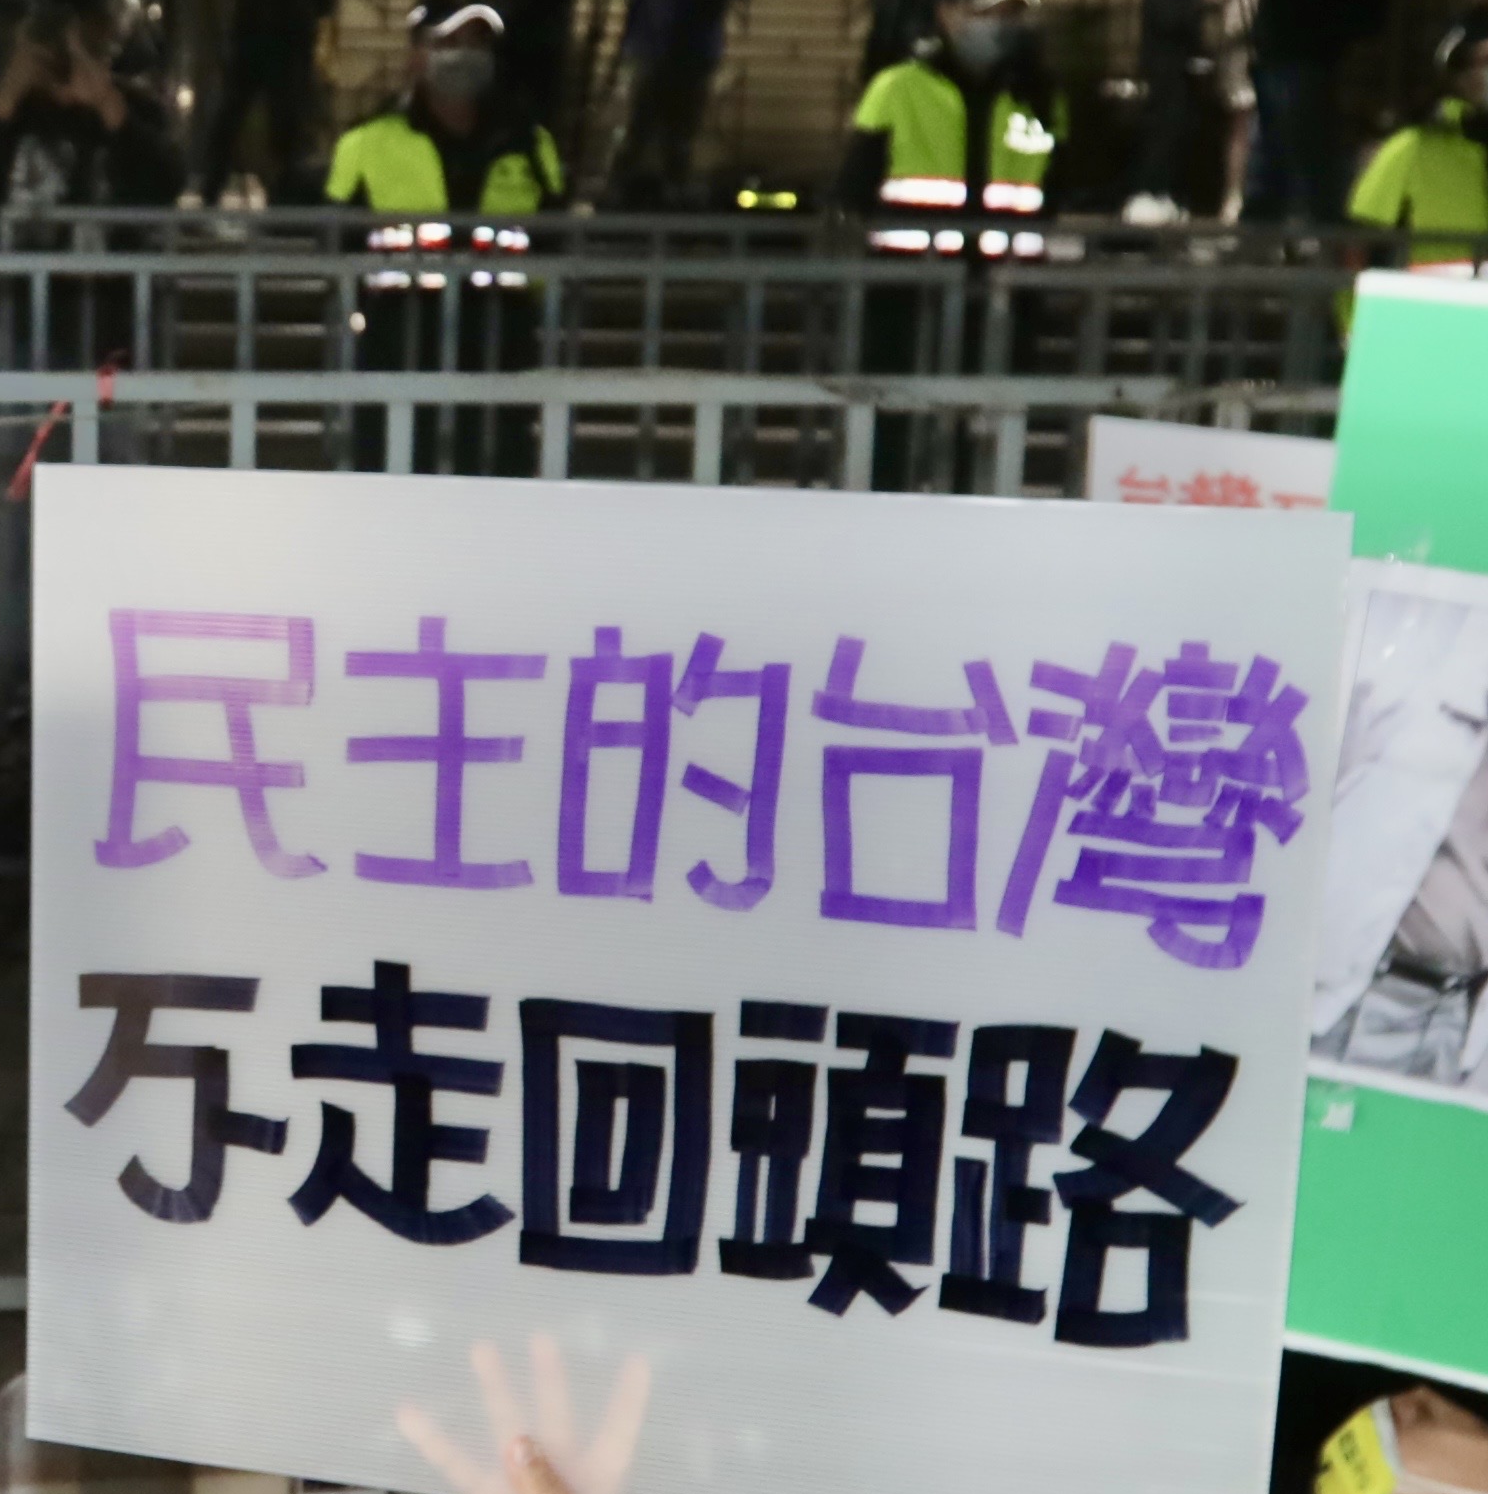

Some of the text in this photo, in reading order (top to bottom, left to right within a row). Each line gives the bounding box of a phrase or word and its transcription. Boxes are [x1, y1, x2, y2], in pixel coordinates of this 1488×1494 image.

[92, 606, 1314, 971] 民主的台灣
[64, 958, 1248, 1350] 不走回頭路
